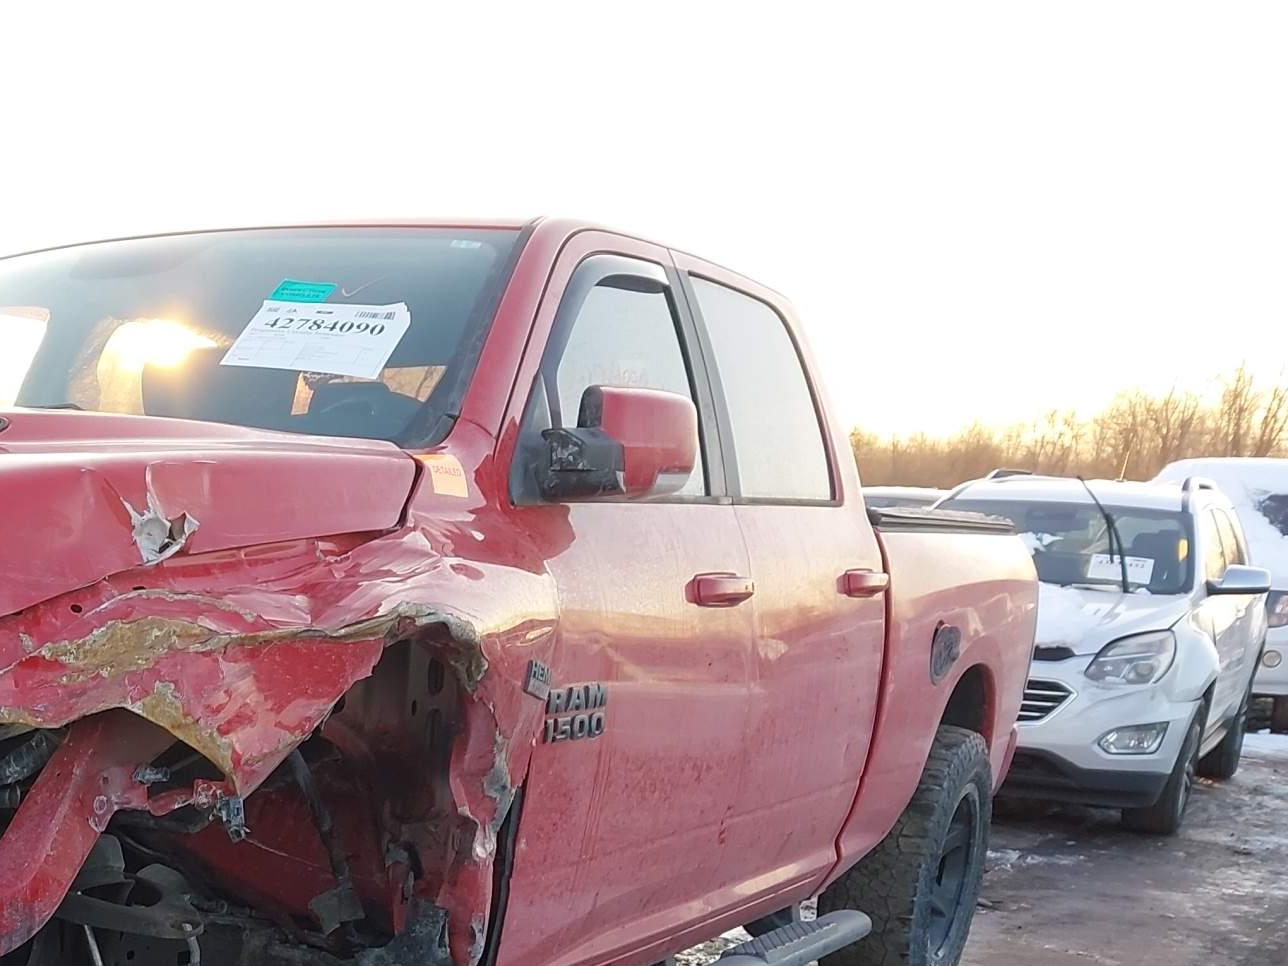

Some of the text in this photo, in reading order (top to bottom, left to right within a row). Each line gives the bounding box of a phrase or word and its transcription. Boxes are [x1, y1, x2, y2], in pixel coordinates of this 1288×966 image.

[264, 316, 385, 336] 42784090
[546, 681, 607, 714] RAM
[543, 712, 606, 743] 1500
